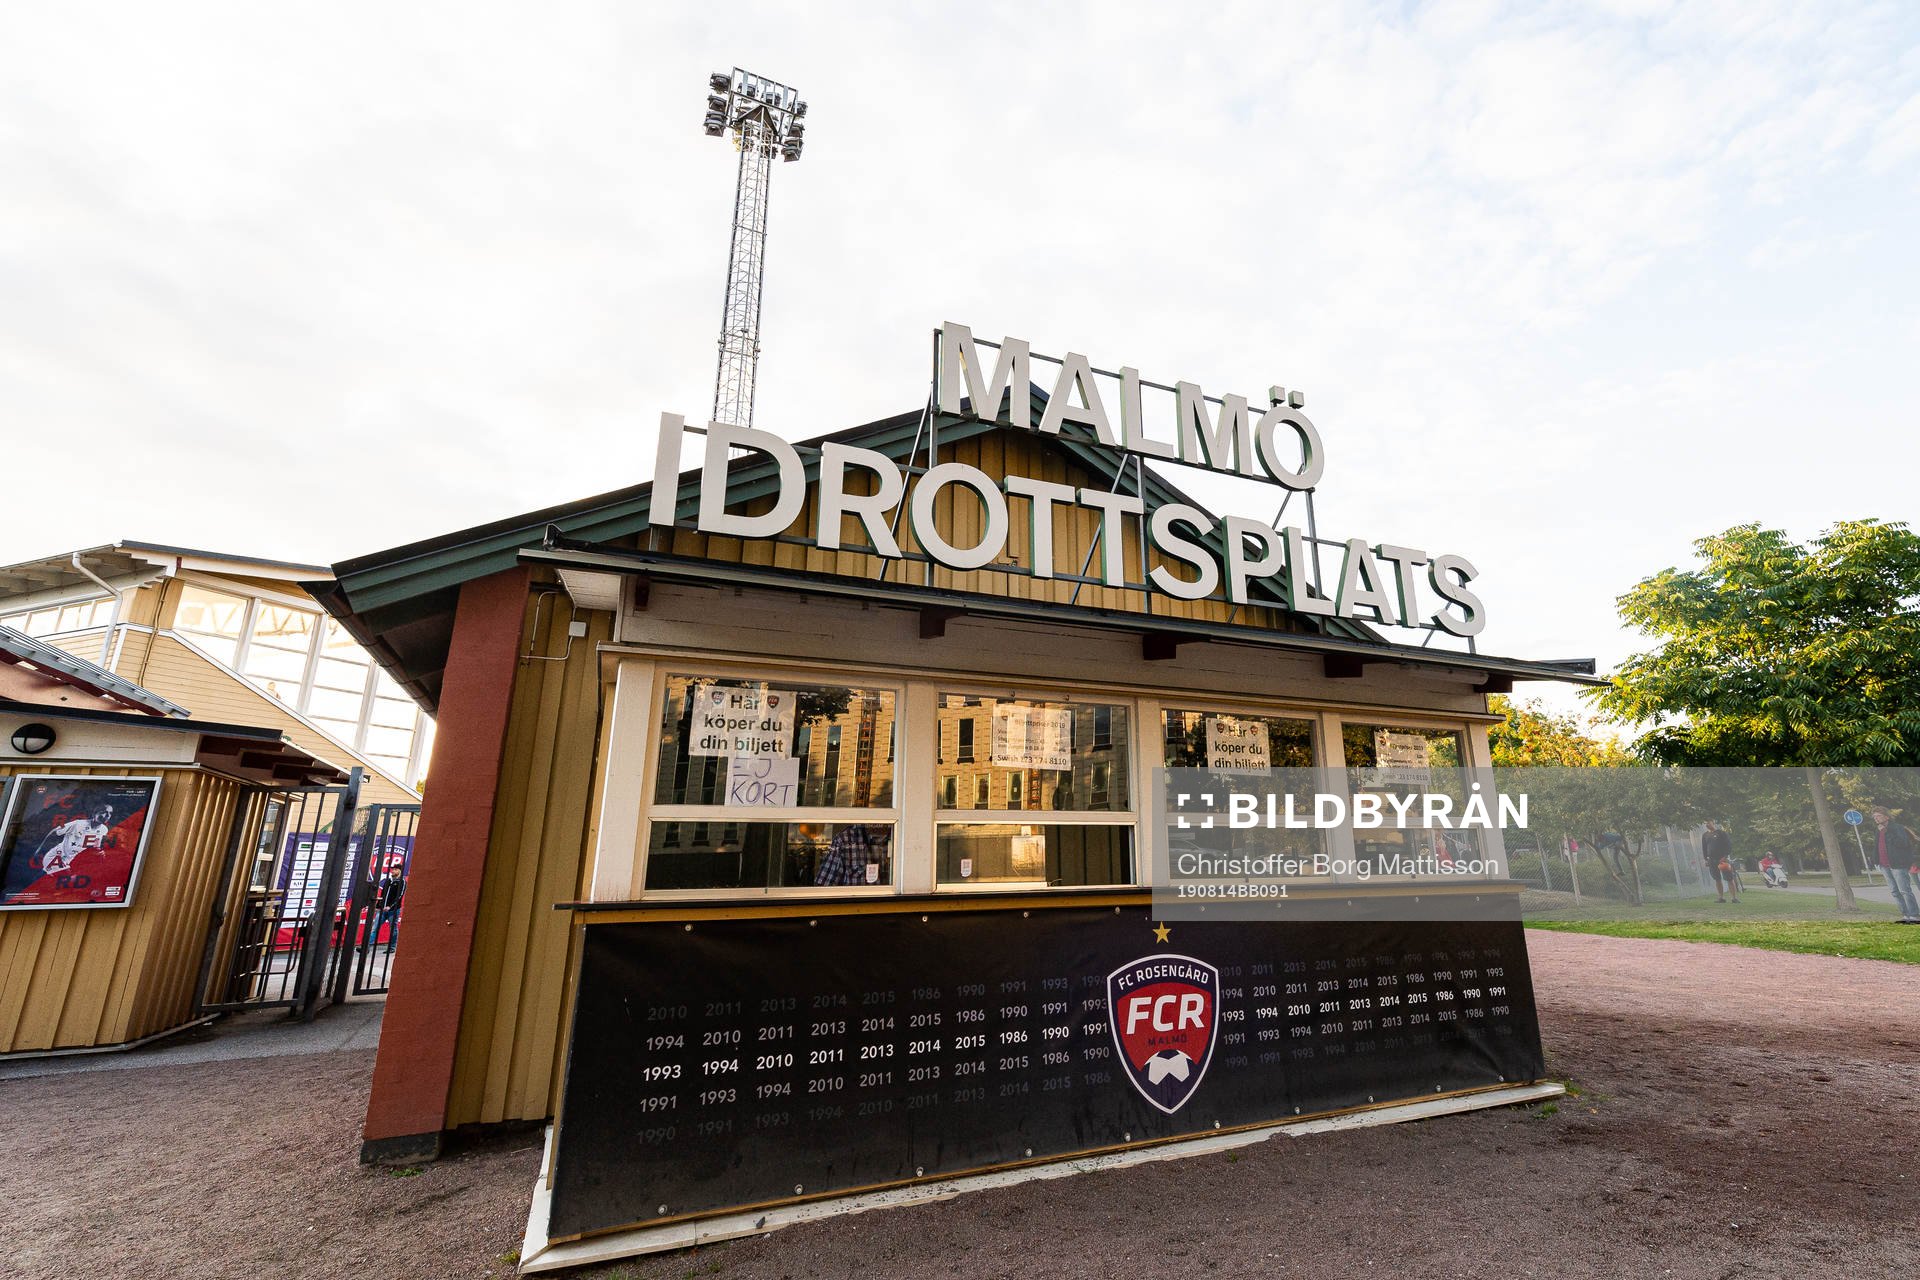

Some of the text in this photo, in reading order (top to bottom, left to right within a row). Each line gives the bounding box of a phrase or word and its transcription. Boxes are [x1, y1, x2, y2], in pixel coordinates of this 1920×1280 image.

[939, 321, 1325, 491] MALMÖ
[648, 412, 1486, 637] IDROTTSPLATS
[730, 695, 760, 709] Här
[704, 714, 782, 732] köper du
[700, 735, 783, 755] din biljett
[1049, 758, 1067, 766] 8110
[1214, 741, 1262, 755] köper du
[1214, 757, 1266, 773] din biljett
[731, 781, 794, 806] KORT
[648, 1005, 687, 1021] 2010
[705, 1001, 741, 1016] 2011
[761, 997, 796, 1012] 2013
[813, 994, 847, 1008] 2014
[862, 991, 895, 1004] 2015
[912, 988, 941, 1000] 1986
[957, 984, 985, 996] 1990
[1000, 981, 1026, 992] 1991
[1042, 978, 1068, 989] 1993
[1252, 964, 1273, 975] 2011
[1284, 962, 1306, 972] 2013
[1316, 960, 1336, 970] 2014
[1117, 964, 1209, 990] FC ROSENGÅRD
[647, 967, 1503, 1050] 1994 2010 2011 2013 2014 2015 1986 1990 1991 1993 1994 2010 2011 2013 2014 2015 1986 1990 1991 1993
[1126, 993, 1205, 1035] FCR
[644, 987, 1506, 1081] 1993 1994 2010 2011 2013 2014 2015 1986 1990 1991 1993 1994 2010 2011 2013 2014 2015 1986 1990 1991
[640, 1006, 1509, 1112] 1991 1993 1994 2010 2011 2013 2014 2015 1986 1990 1991 1993 1994 2010 2011 2013 2014 2015 1986 1990
[637, 1126, 675, 1143] 1990
[698, 1120, 732, 1135] 1991
[756, 1112, 789, 1128] 1993
[809, 1106, 841, 1120] 1994
[859, 1100, 892, 1115] 2010
[908, 1093, 938, 1108] 2011
[955, 1088, 985, 1102] 2013
[1000, 1082, 1029, 1096] 2014
[1043, 1076, 1071, 1090] 2015
[1084, 1072, 1111, 1084] 1986
[1225, 1056, 1248, 1067] 1990
[1260, 1052, 1280, 1063] 1991
[1292, 1048, 1314, 1059] 1993
